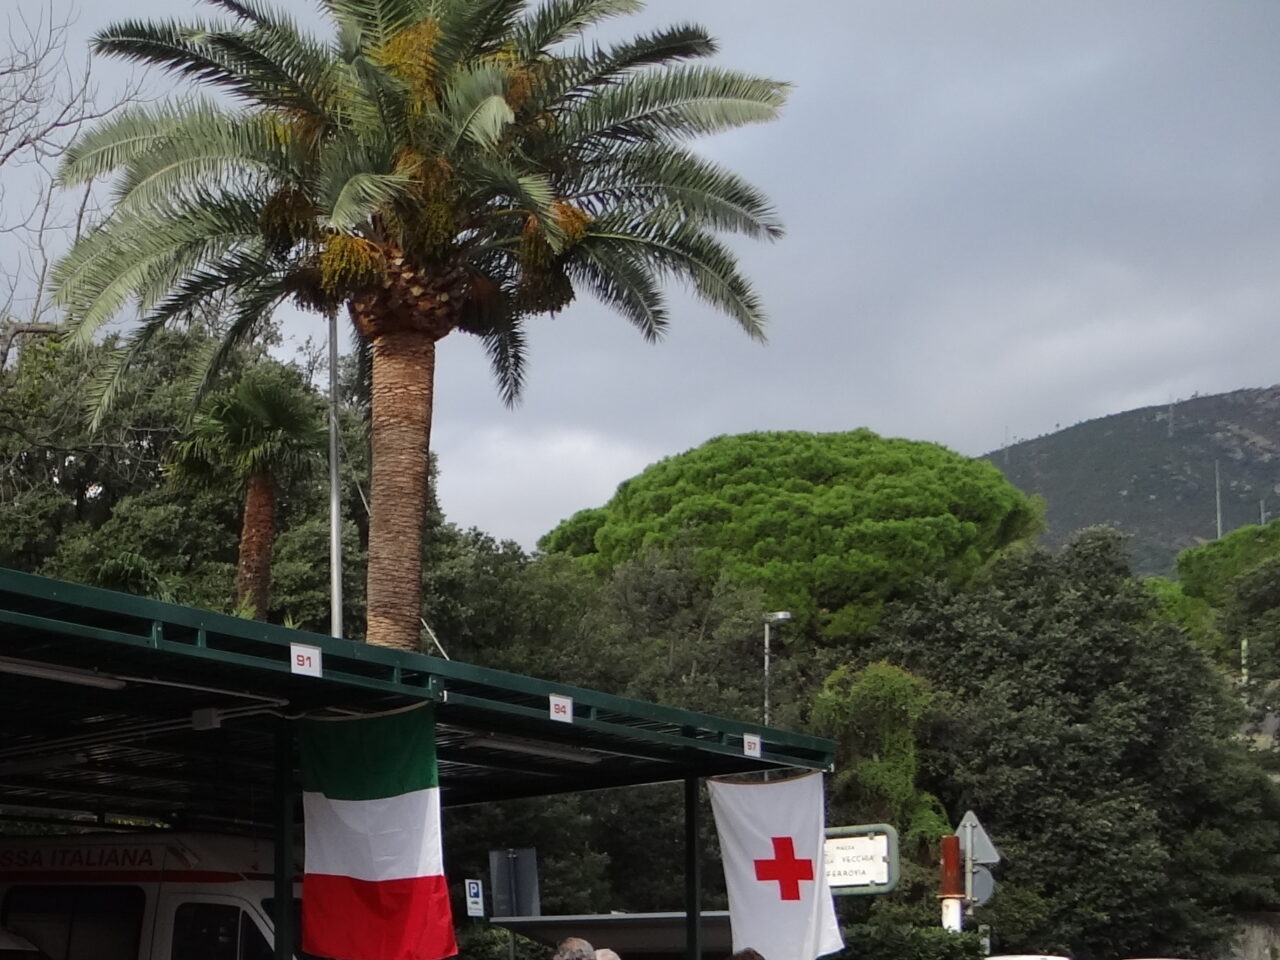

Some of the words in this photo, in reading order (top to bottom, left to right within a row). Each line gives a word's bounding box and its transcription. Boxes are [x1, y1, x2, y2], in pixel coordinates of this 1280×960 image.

[296, 655, 312, 668] 91
[554, 703, 567, 715] 94
[50, 848, 154, 867] ITALIANA
